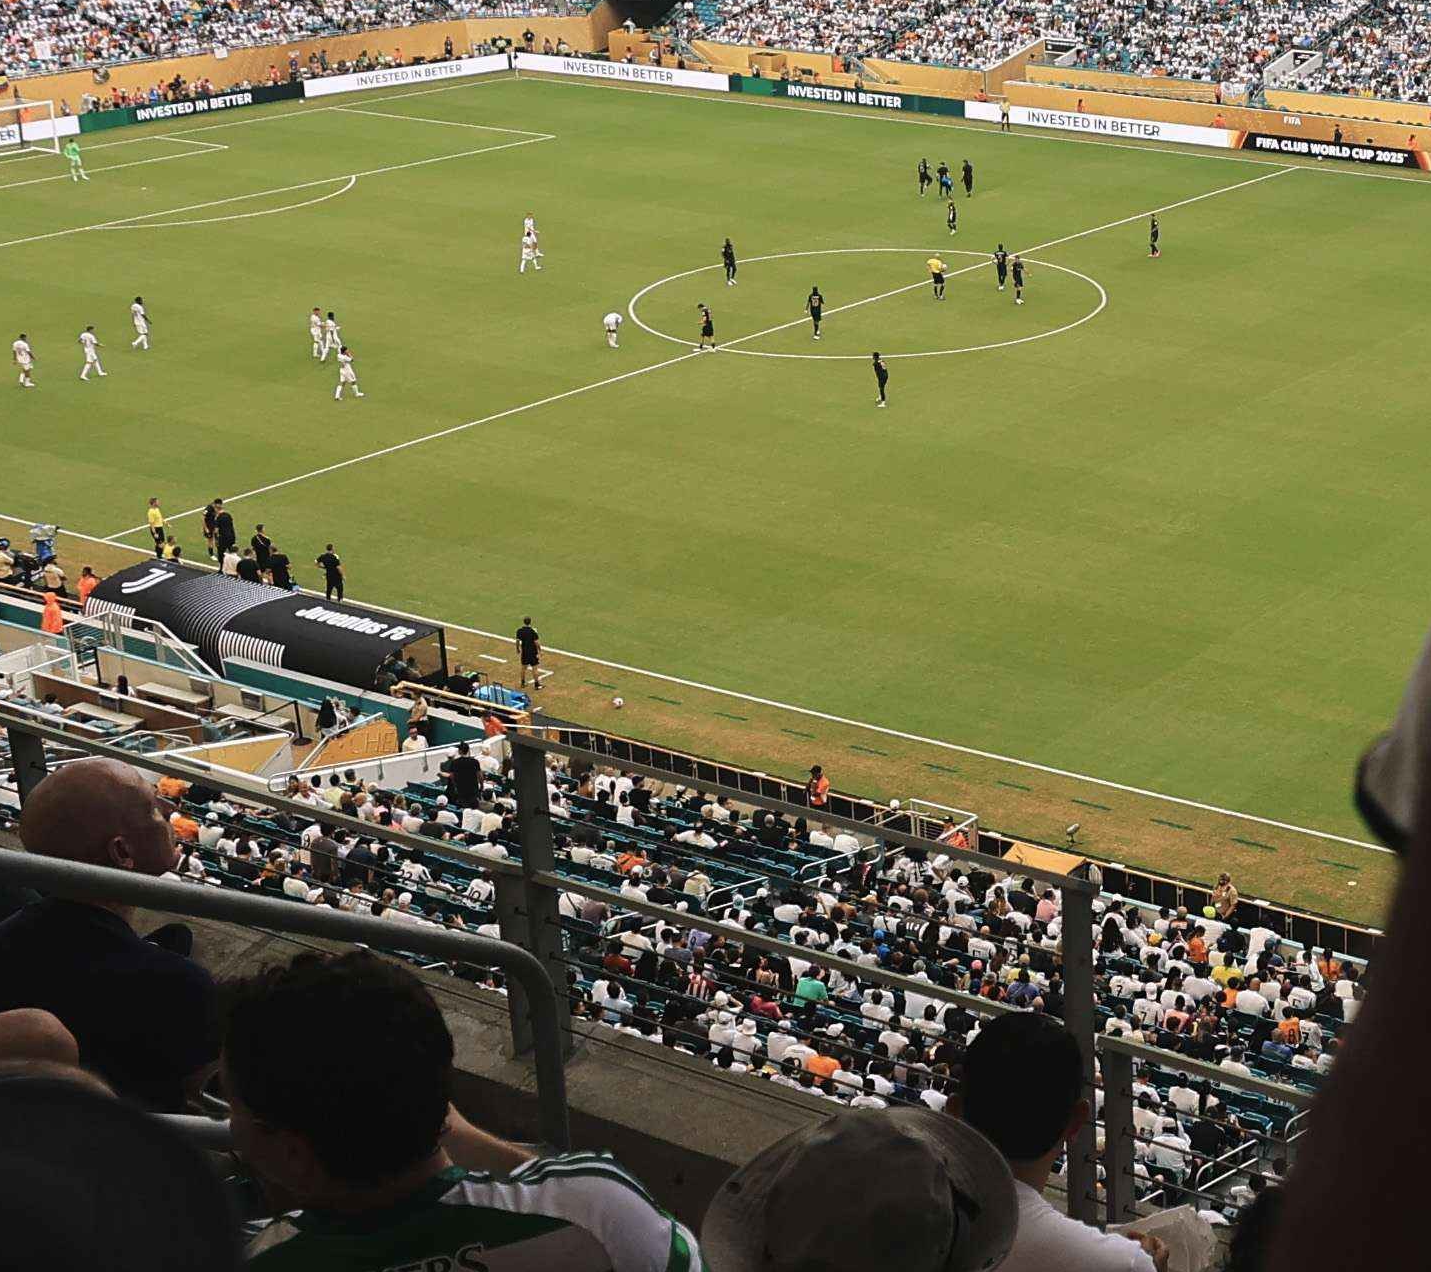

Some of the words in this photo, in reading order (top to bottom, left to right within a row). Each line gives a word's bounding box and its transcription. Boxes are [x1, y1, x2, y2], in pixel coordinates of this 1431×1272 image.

[356, 72, 408, 86] INVESTED
[410, 70, 422, 80] IN
[424, 63, 462, 77] BETTER
[563, 60, 616, 76] INVESTED
[618, 65, 629, 76] IN
[633, 68, 673, 82] BETTER
[136, 102, 193, 121] INVESTED
[195, 100, 208, 112] IN
[210, 92, 252, 109] BETTER
[787, 83, 841, 100] INVESTED
[845, 91, 858, 103] IN
[859, 92, 902, 109] BETTER
[1028, 110, 1090, 129] INVESTED
[1094, 118, 1107, 130] IN
[1111, 121, 1160, 137] BETTER
[1283, 115, 1302, 126] FIFA
[1255, 136, 1280, 150] FIFA
[1281, 139, 1309, 153] CLUB
[1310, 142, 1350, 158] WORLD
[1352, 147, 1375, 161] CUP
[294, 606, 388, 635] Juventus
[379, 625, 416, 641] FC
